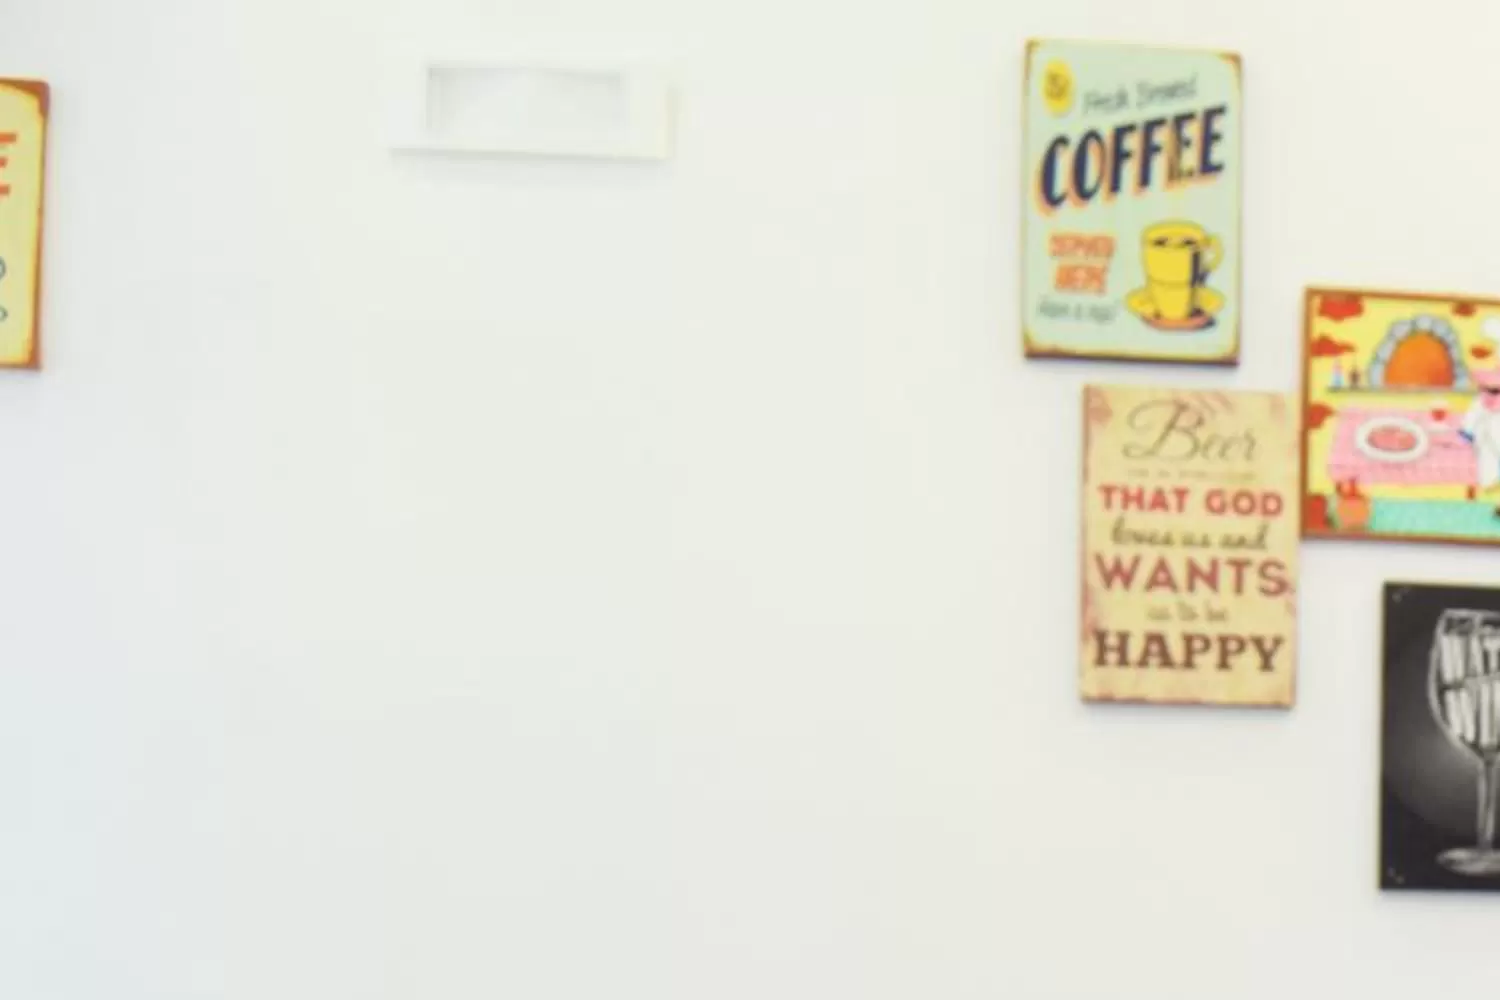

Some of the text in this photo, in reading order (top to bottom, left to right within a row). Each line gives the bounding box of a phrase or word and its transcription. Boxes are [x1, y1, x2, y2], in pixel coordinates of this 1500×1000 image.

[1037, 103, 1227, 213] COFFEE
[1121, 396, 1258, 463] Beer
[1097, 483, 1284, 518] THAT GOD
[1094, 552, 1291, 599] WANTS
[1091, 628, 1286, 674] HAPPY
